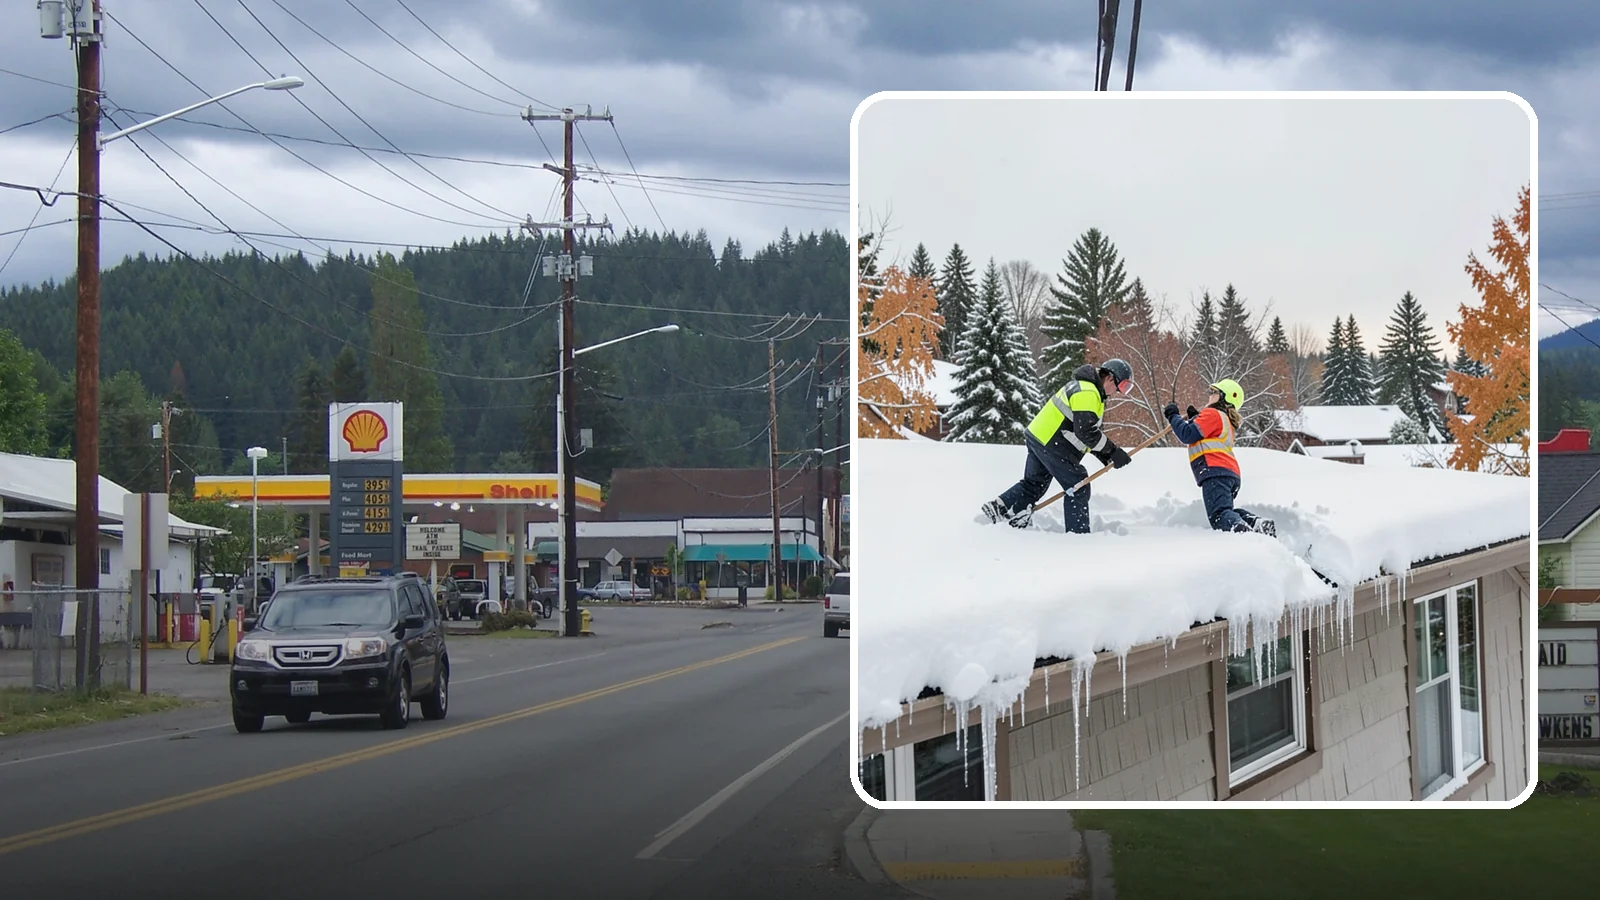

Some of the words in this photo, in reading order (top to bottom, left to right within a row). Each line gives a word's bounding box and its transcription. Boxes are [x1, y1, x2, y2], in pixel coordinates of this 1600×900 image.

[365, 480, 384, 490] 395
[490, 484, 547, 499] Shell
[365, 494, 383, 504] 405
[365, 508, 383, 518] 415
[366, 522, 384, 533] 429
